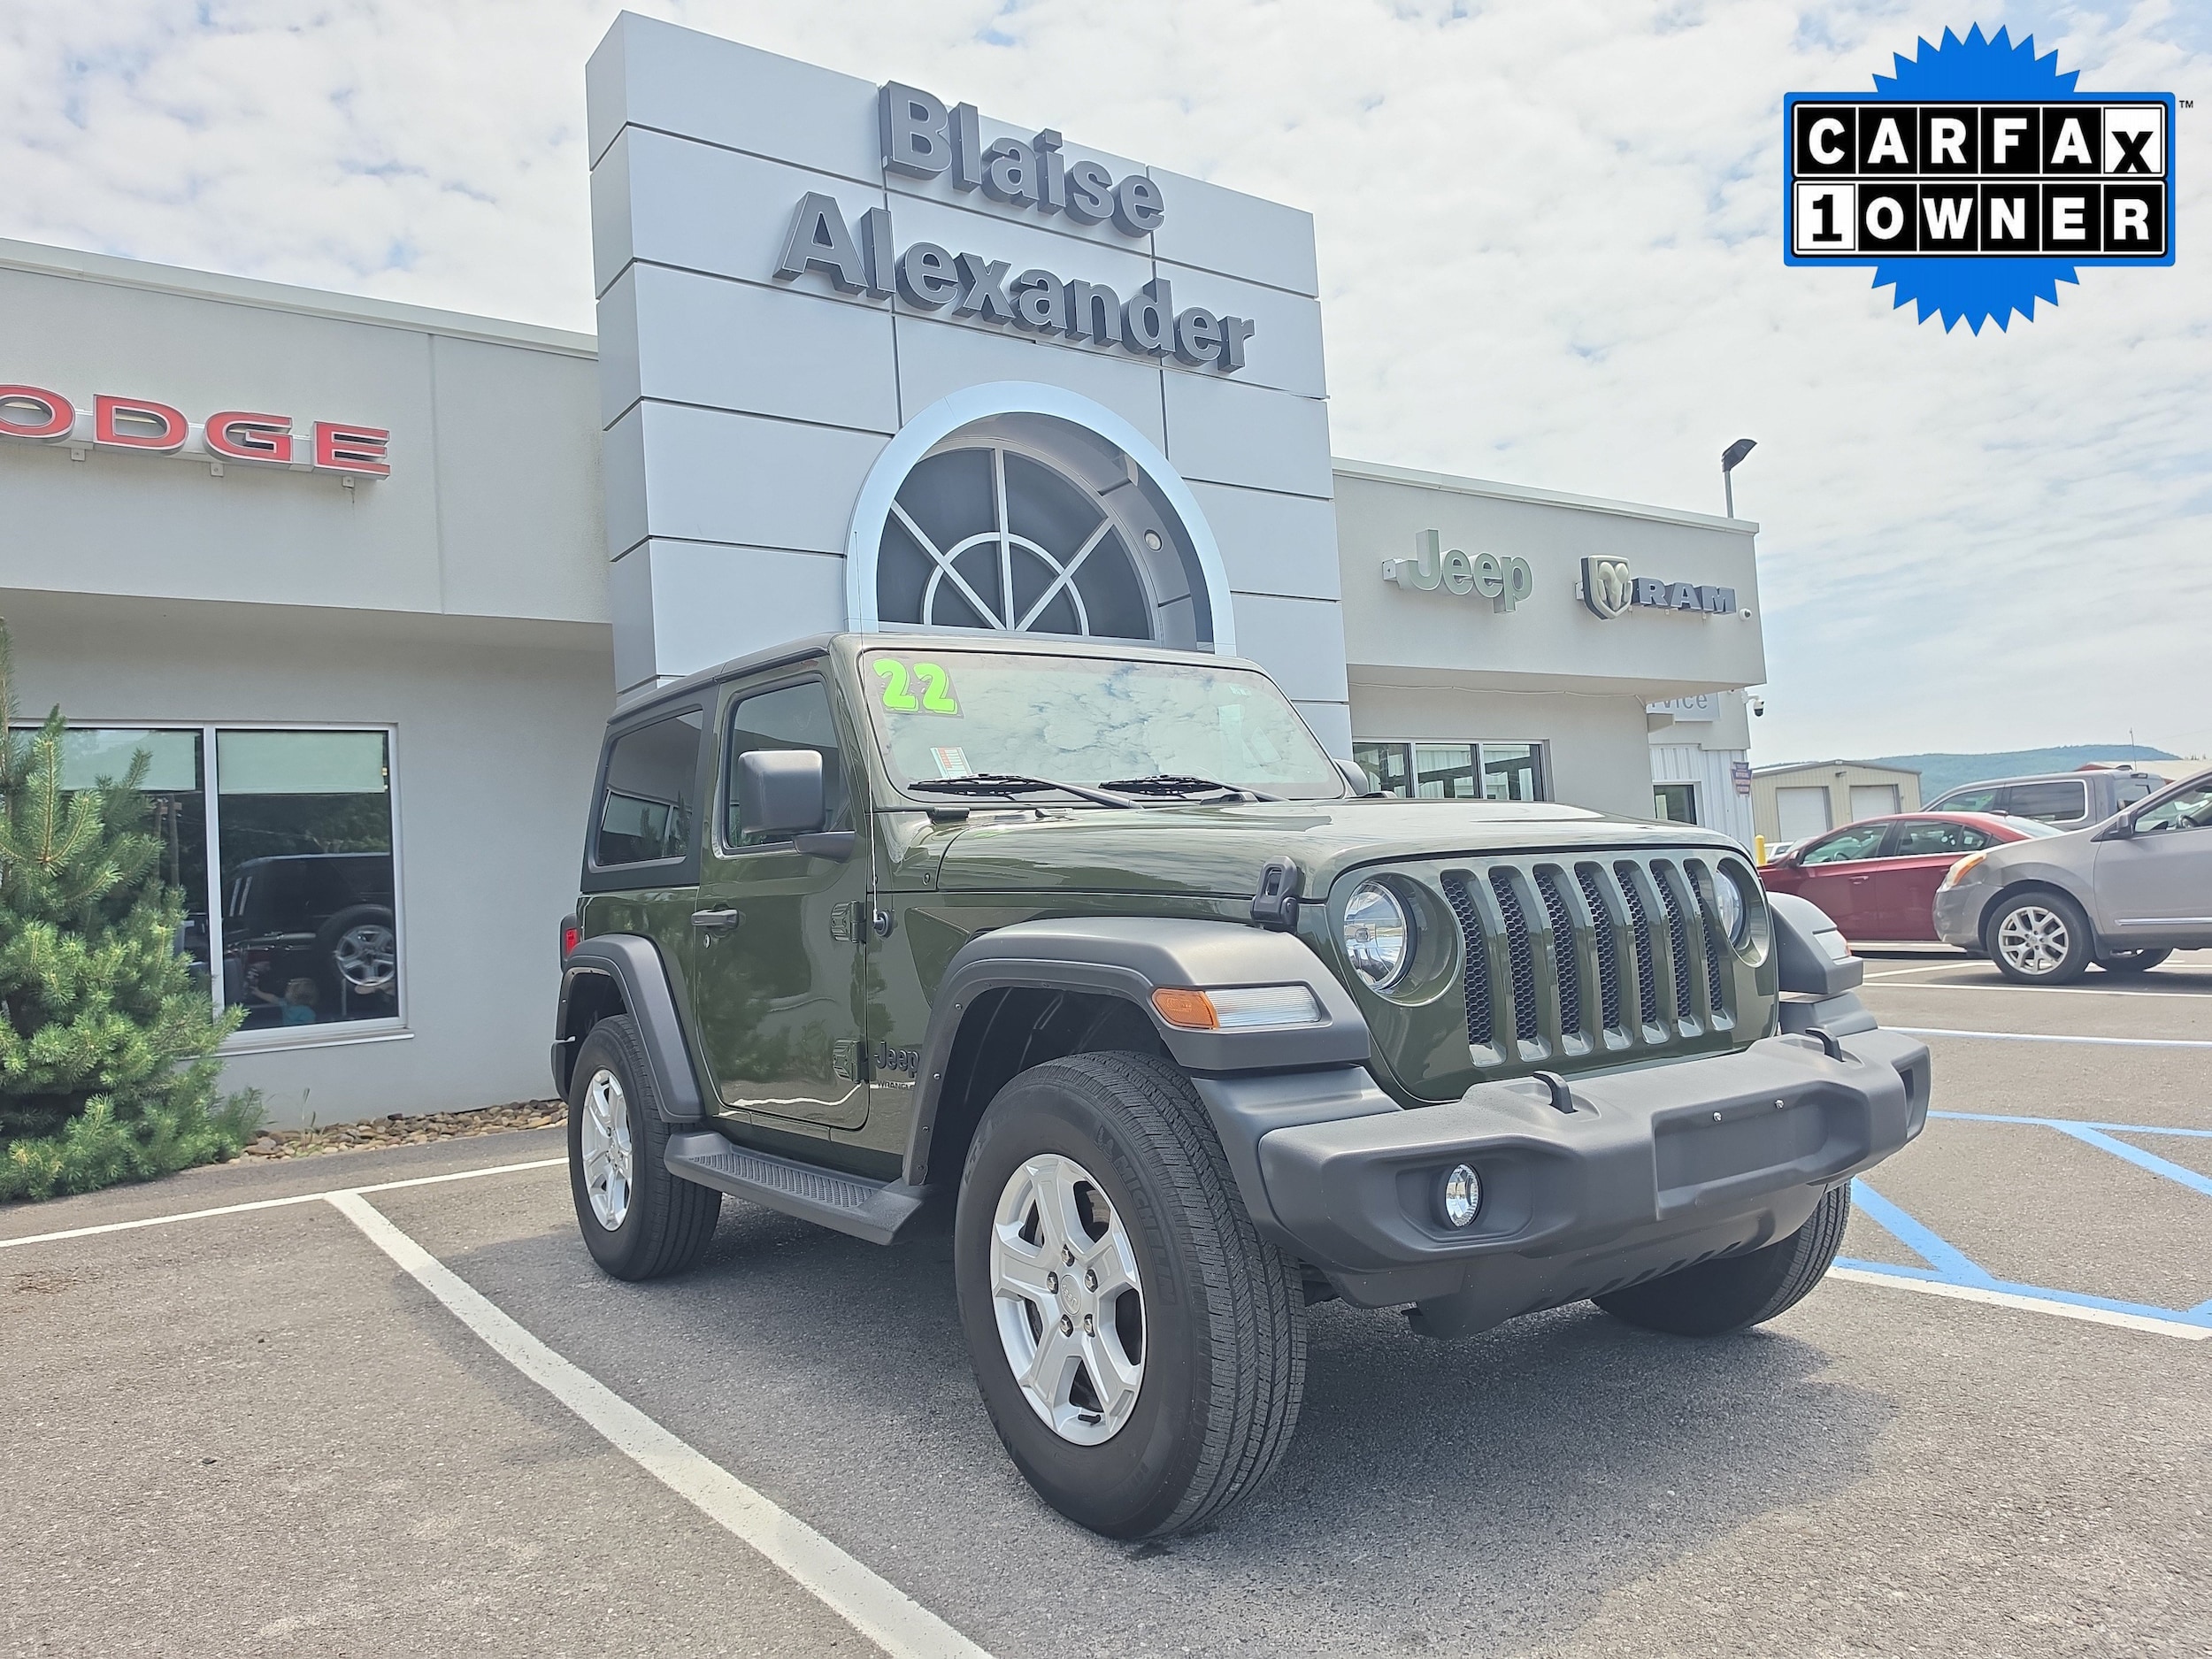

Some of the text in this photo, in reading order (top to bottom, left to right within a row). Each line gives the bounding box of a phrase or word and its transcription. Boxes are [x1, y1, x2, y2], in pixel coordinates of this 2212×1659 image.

[881, 81, 1166, 237] Blaise
[772, 191, 1256, 373] Alexander
[0, 383, 391, 480] ODGE
[1396, 529, 1534, 612] Jeep
[1632, 577, 1737, 615] RAM
[873, 658, 958, 715] 22
[873, 1041, 920, 1079] Jeep
[877, 1079, 916, 1090] WRANGLE
